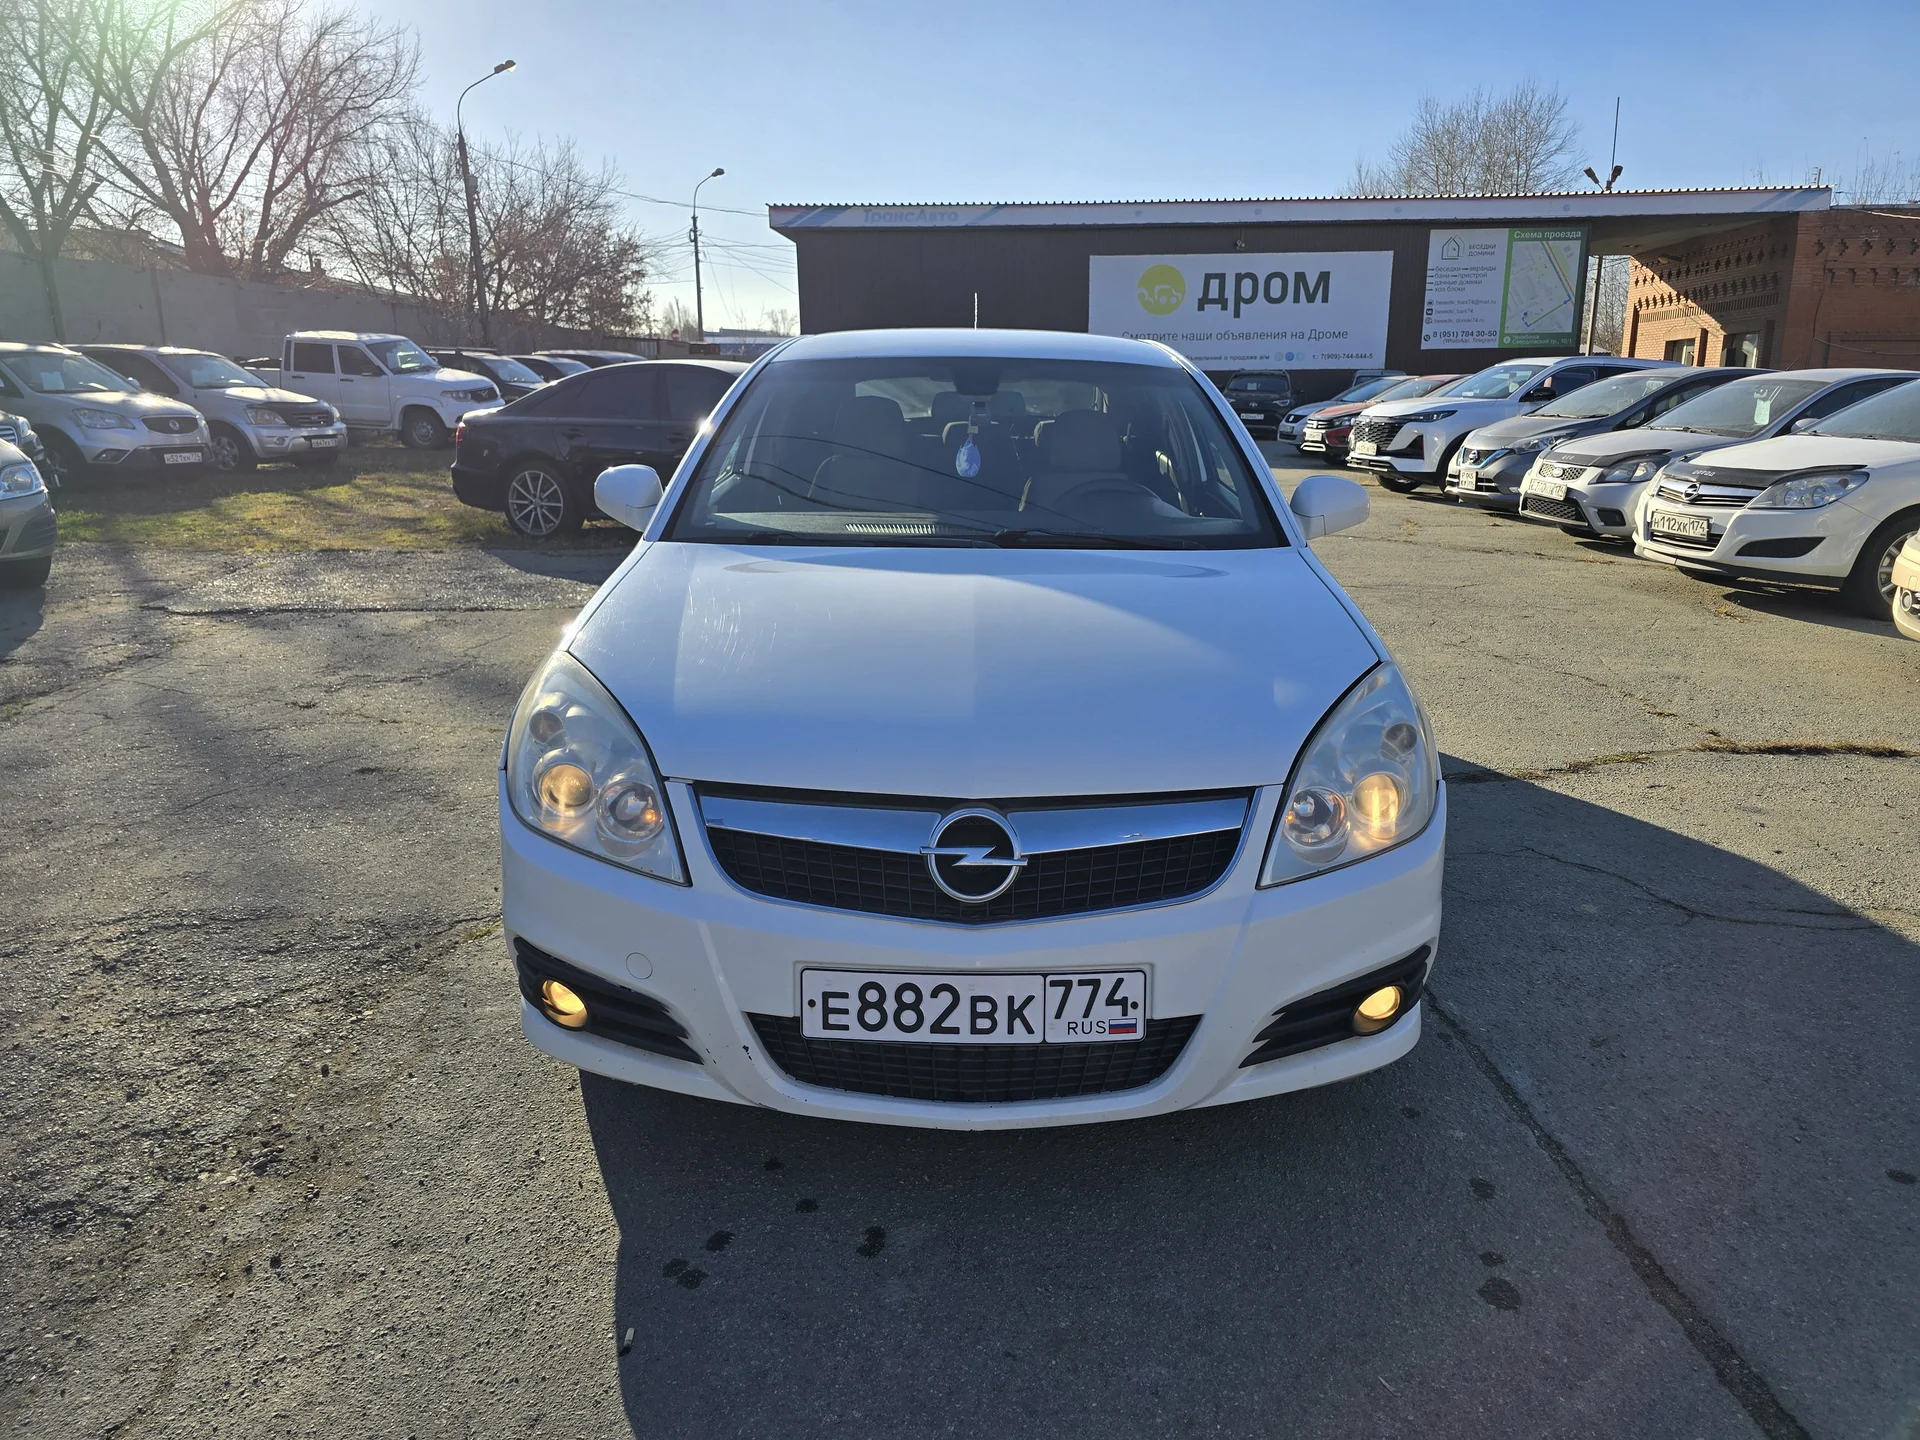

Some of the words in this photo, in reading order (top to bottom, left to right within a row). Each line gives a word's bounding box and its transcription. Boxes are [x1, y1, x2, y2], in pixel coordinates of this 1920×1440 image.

[863, 209, 958, 224] ТрансАвто
[1514, 231, 1542, 239] Схема
[1544, 231, 1582, 240] проезда
[1197, 270, 1331, 319] дром
[1122, 331, 1179, 341] Смотрите
[1182, 332, 1212, 341] наши
[1216, 330, 1287, 341] объявления
[1290, 332, 1305, 340] на
[1308, 329, 1348, 341] Дроме
[1654, 516, 1688, 533] Н112ХК
[1690, 520, 1705, 532] 174
[822, 980, 1036, 1035] Е882ВК
[1049, 977, 1129, 1018] 774
[1067, 1020, 1106, 1035] RUS
